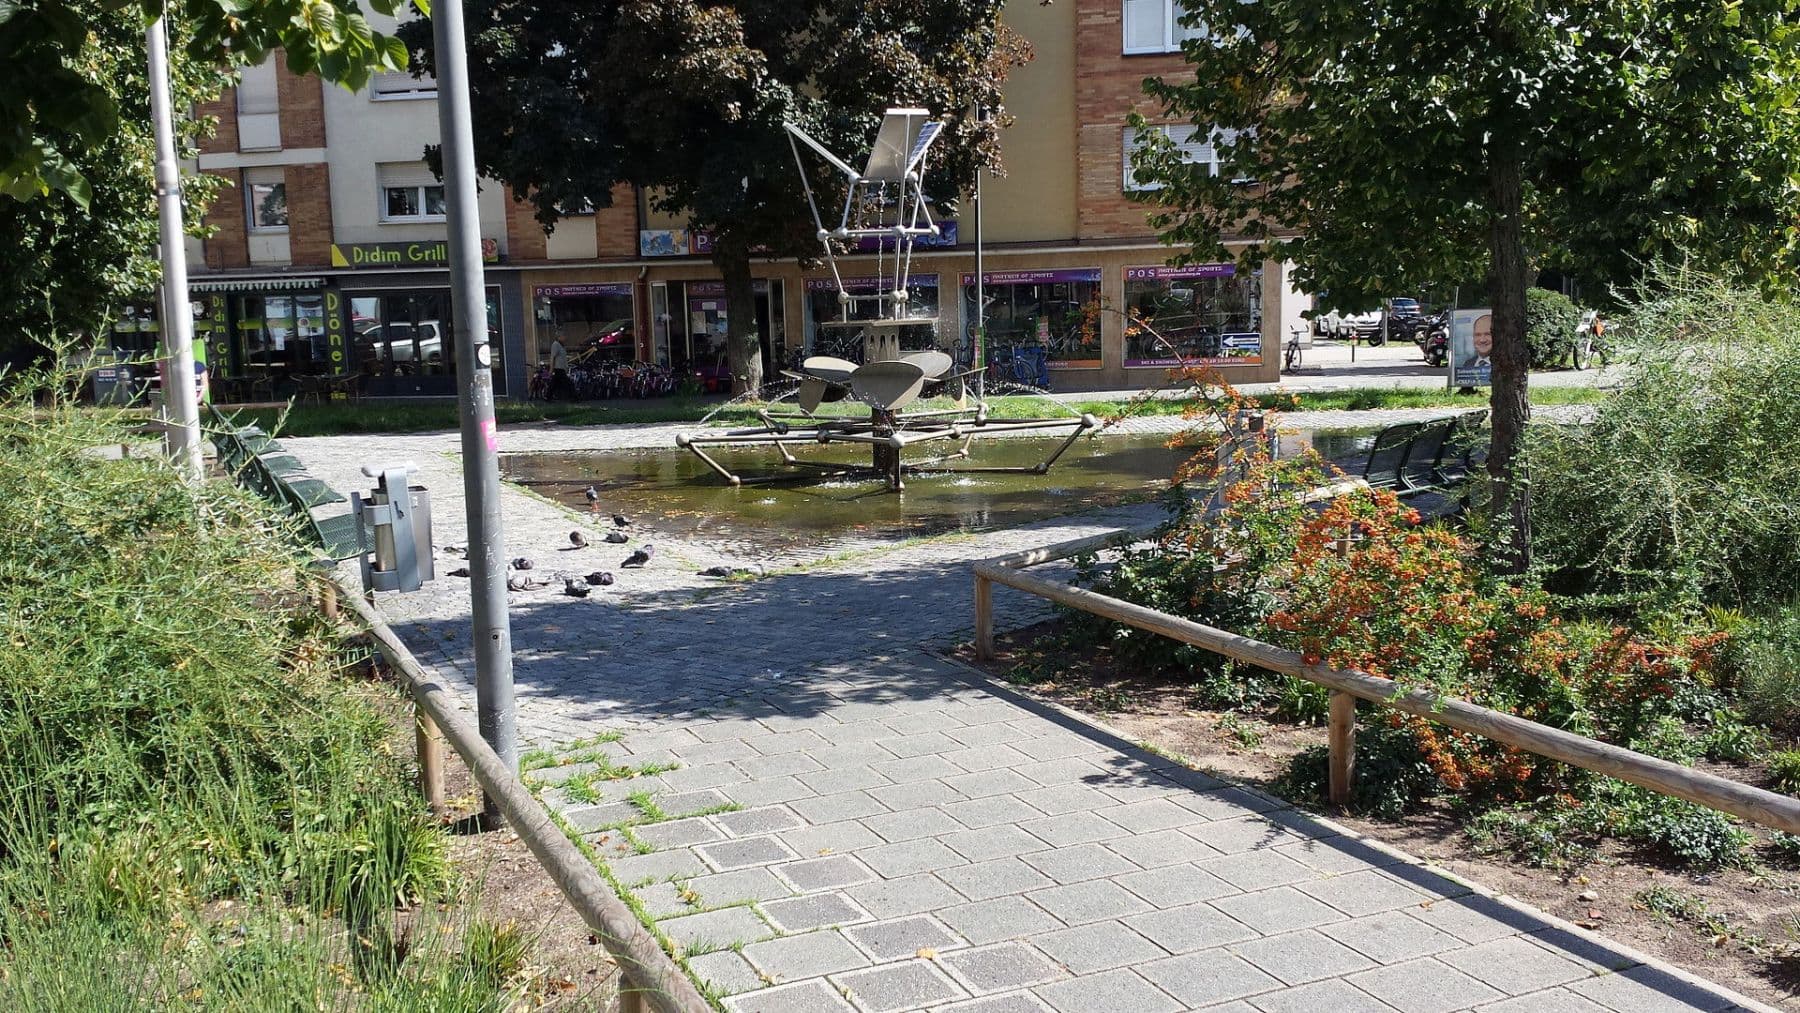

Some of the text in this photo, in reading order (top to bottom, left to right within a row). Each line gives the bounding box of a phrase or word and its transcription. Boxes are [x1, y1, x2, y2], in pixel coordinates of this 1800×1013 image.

[352, 243, 446, 263] Didim Grill
[1030, 271, 1054, 279] SPORTS
[1128, 268, 1156, 278] POS
[1188, 265, 1196, 273] OF
[1197, 264, 1223, 273] SPORTS
[536, 287, 561, 296] POS
[326, 292, 342, 375] Döner
